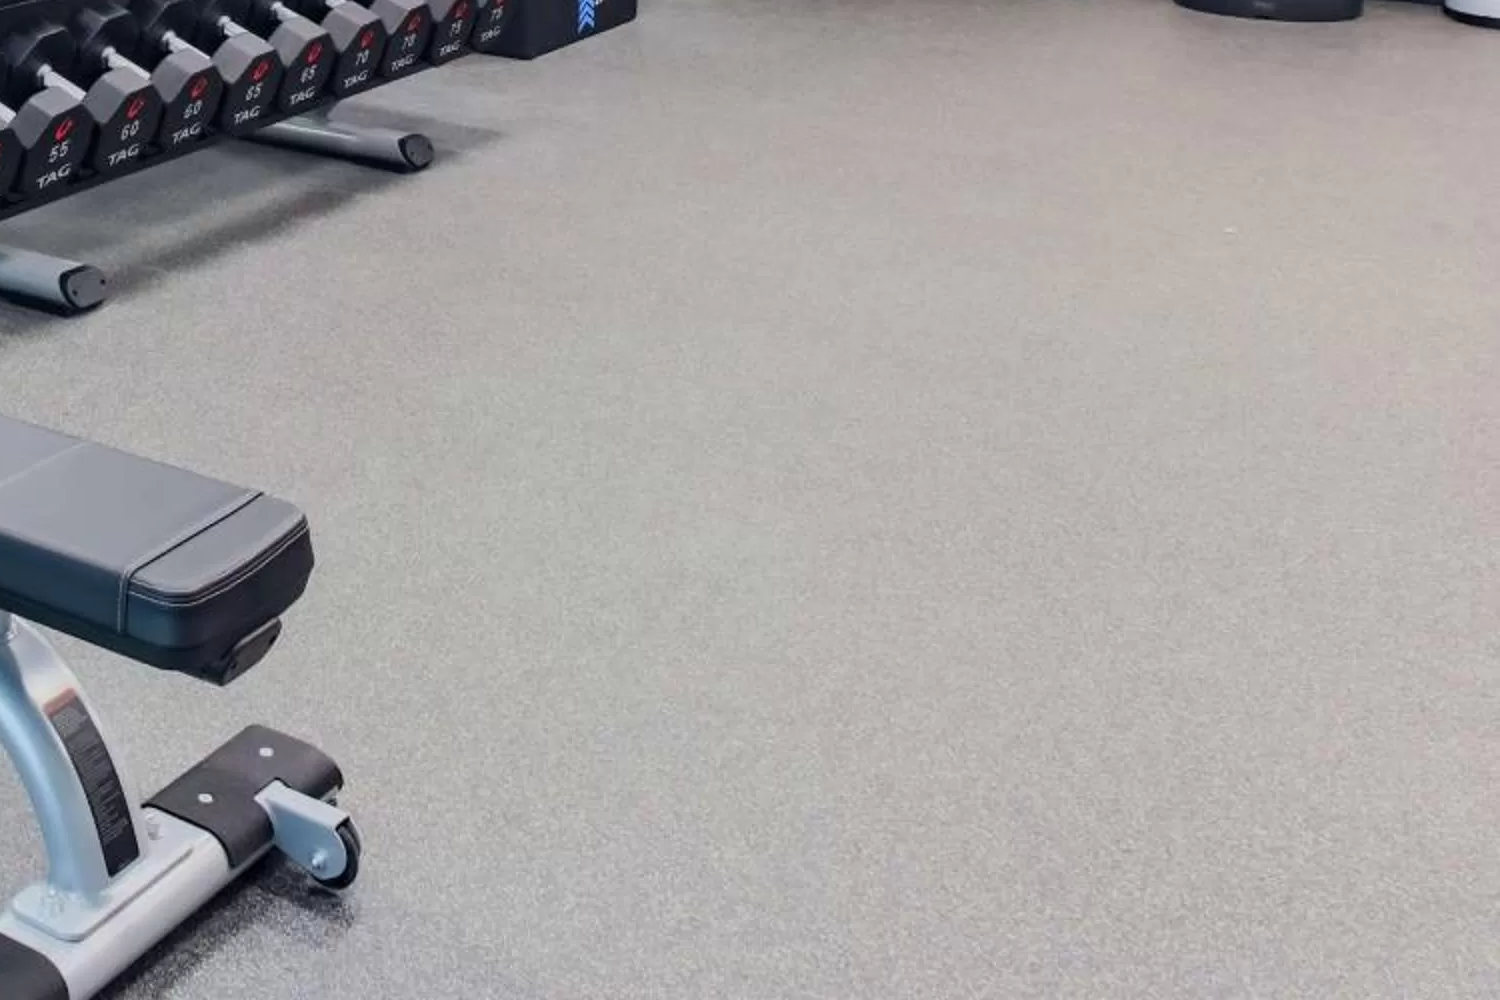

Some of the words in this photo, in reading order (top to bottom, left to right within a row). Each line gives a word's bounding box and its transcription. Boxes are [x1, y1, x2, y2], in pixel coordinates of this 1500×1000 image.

[401, 33, 417, 50] 70
[479, 24, 503, 44] TAG
[355, 48, 371, 66] 70
[438, 38, 462, 57] TAG
[390, 53, 415, 72] TAG
[299, 64, 317, 84] 65
[342, 70, 369, 89] TAG
[245, 83, 263, 101] 65
[289, 85, 316, 107] TAG
[183, 99, 203, 120] 60
[233, 105, 262, 125] TAG
[120, 119, 141, 140] 60
[171, 120, 202, 145] TAG
[48, 139, 70, 164] 55
[107, 143, 141, 167] TAG
[36, 163, 72, 190] TAG
